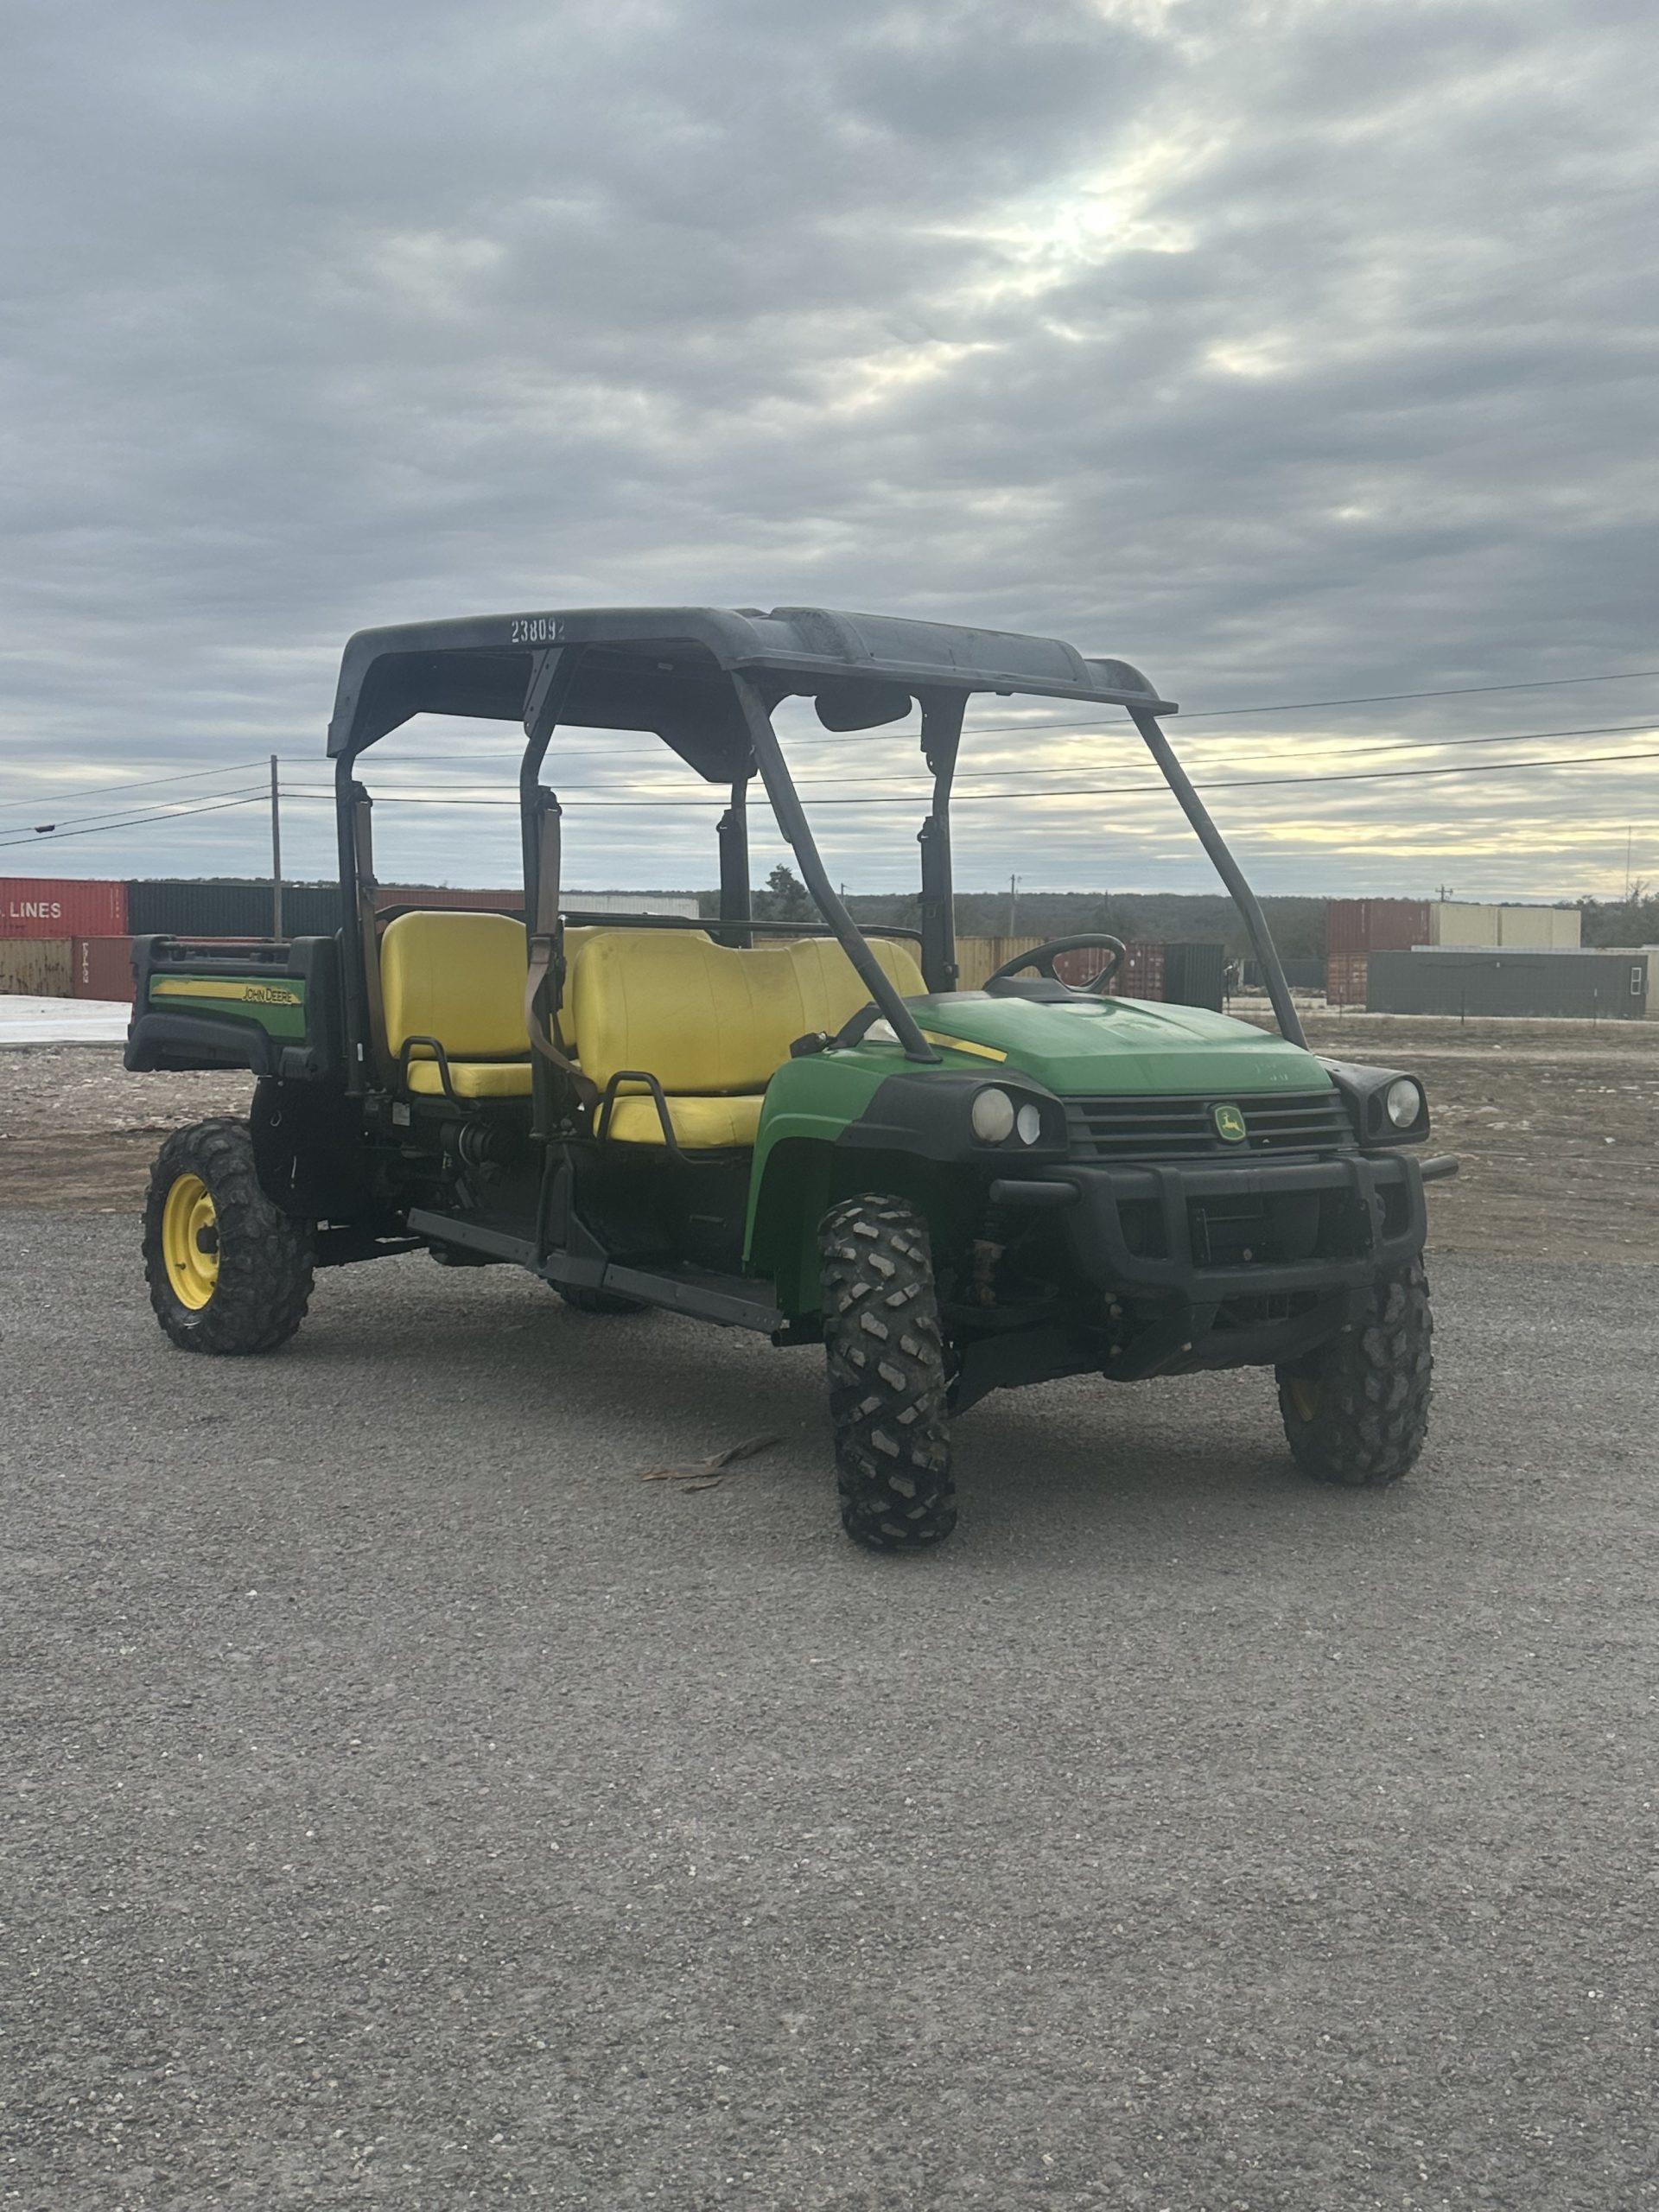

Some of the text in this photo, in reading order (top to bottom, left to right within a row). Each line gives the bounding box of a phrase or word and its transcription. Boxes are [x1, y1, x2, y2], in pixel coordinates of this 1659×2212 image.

[10, 901, 61, 918] LINES
[243, 986, 292, 1003] JOHN DEERE
